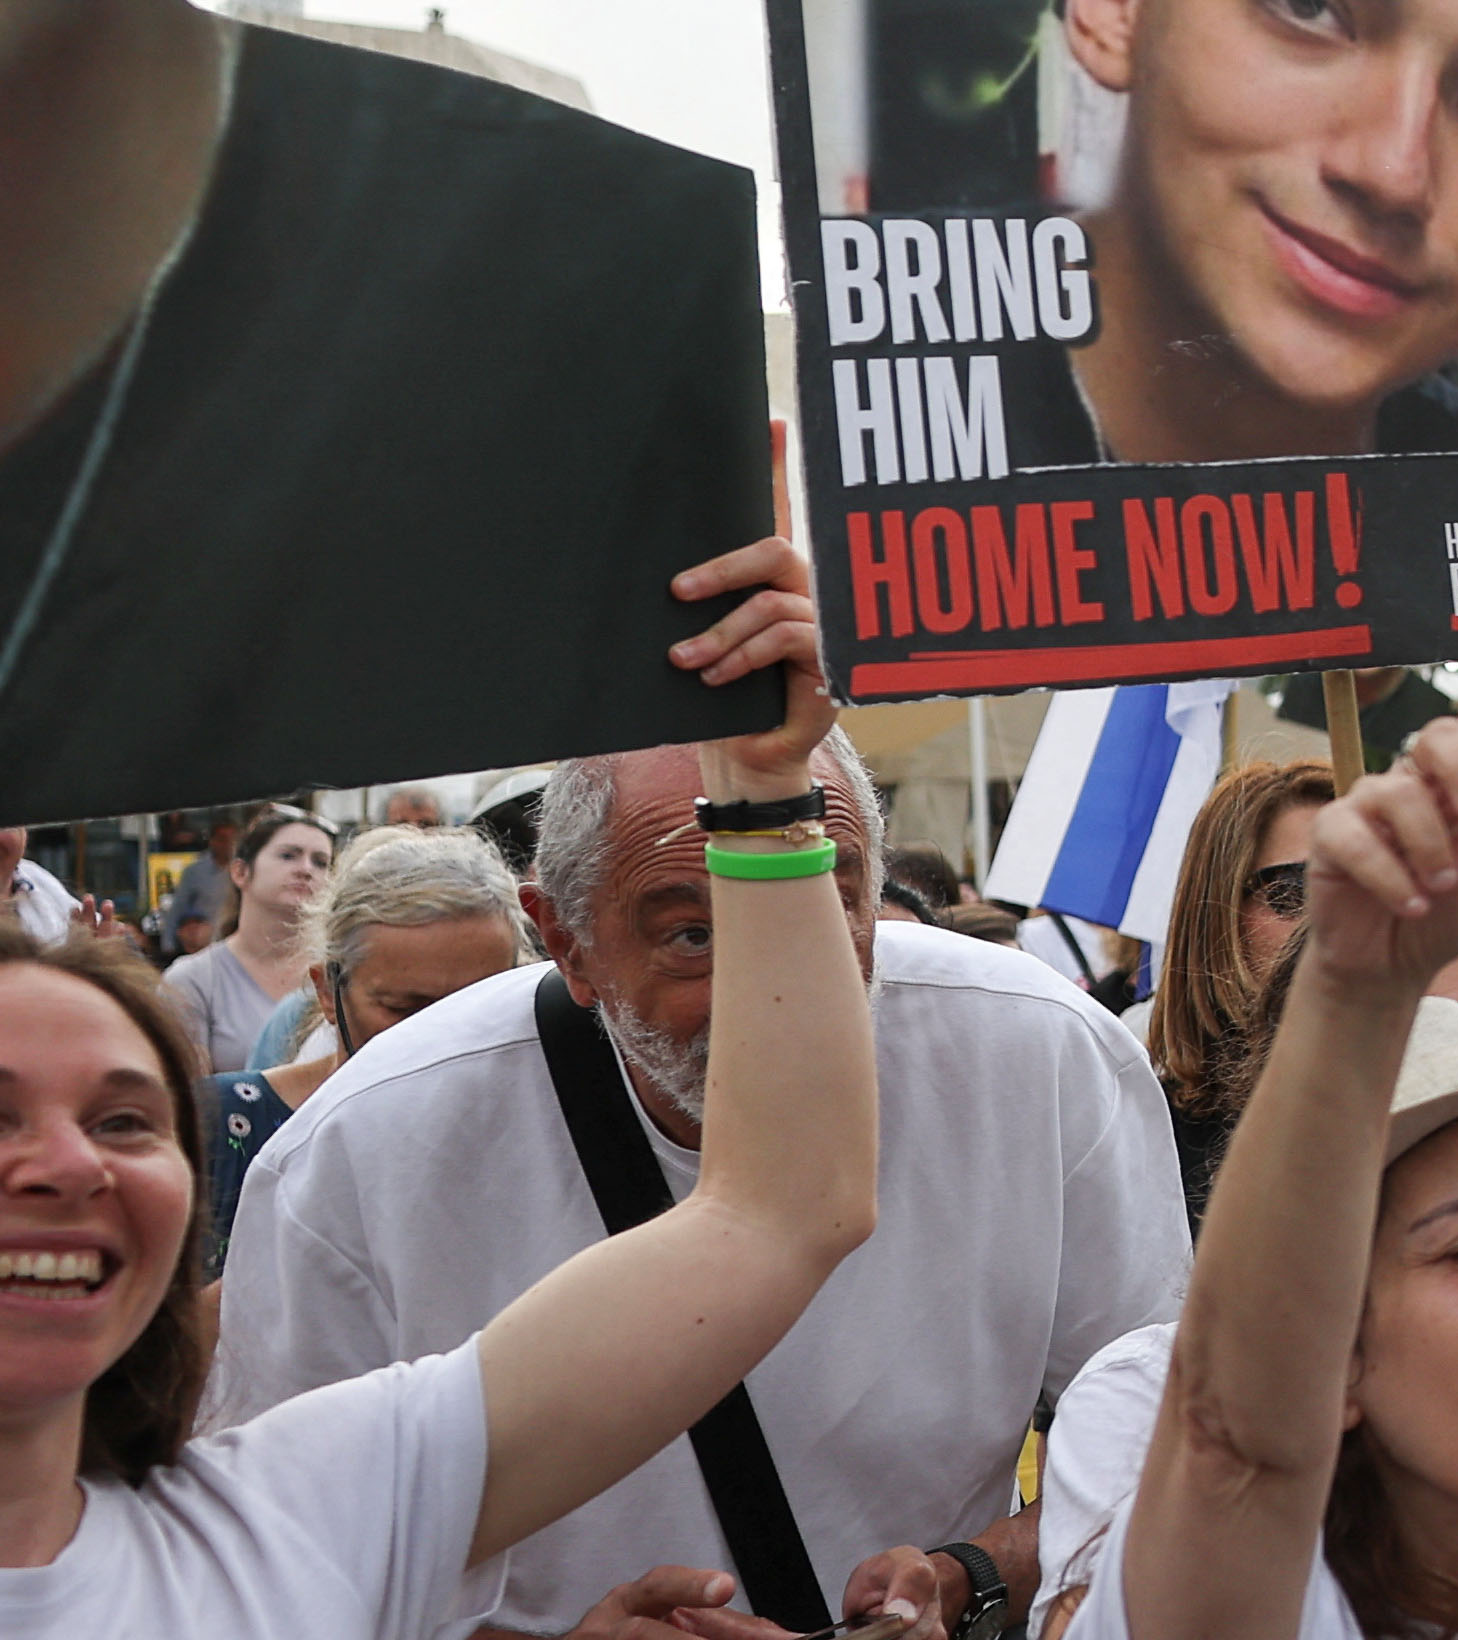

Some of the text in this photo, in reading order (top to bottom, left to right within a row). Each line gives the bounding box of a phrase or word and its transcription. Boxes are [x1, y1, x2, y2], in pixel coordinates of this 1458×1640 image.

[821, 216, 1094, 347] BRING
[833, 355, 1008, 486] HIM
[846, 472, 1363, 641] HOME NOW!
